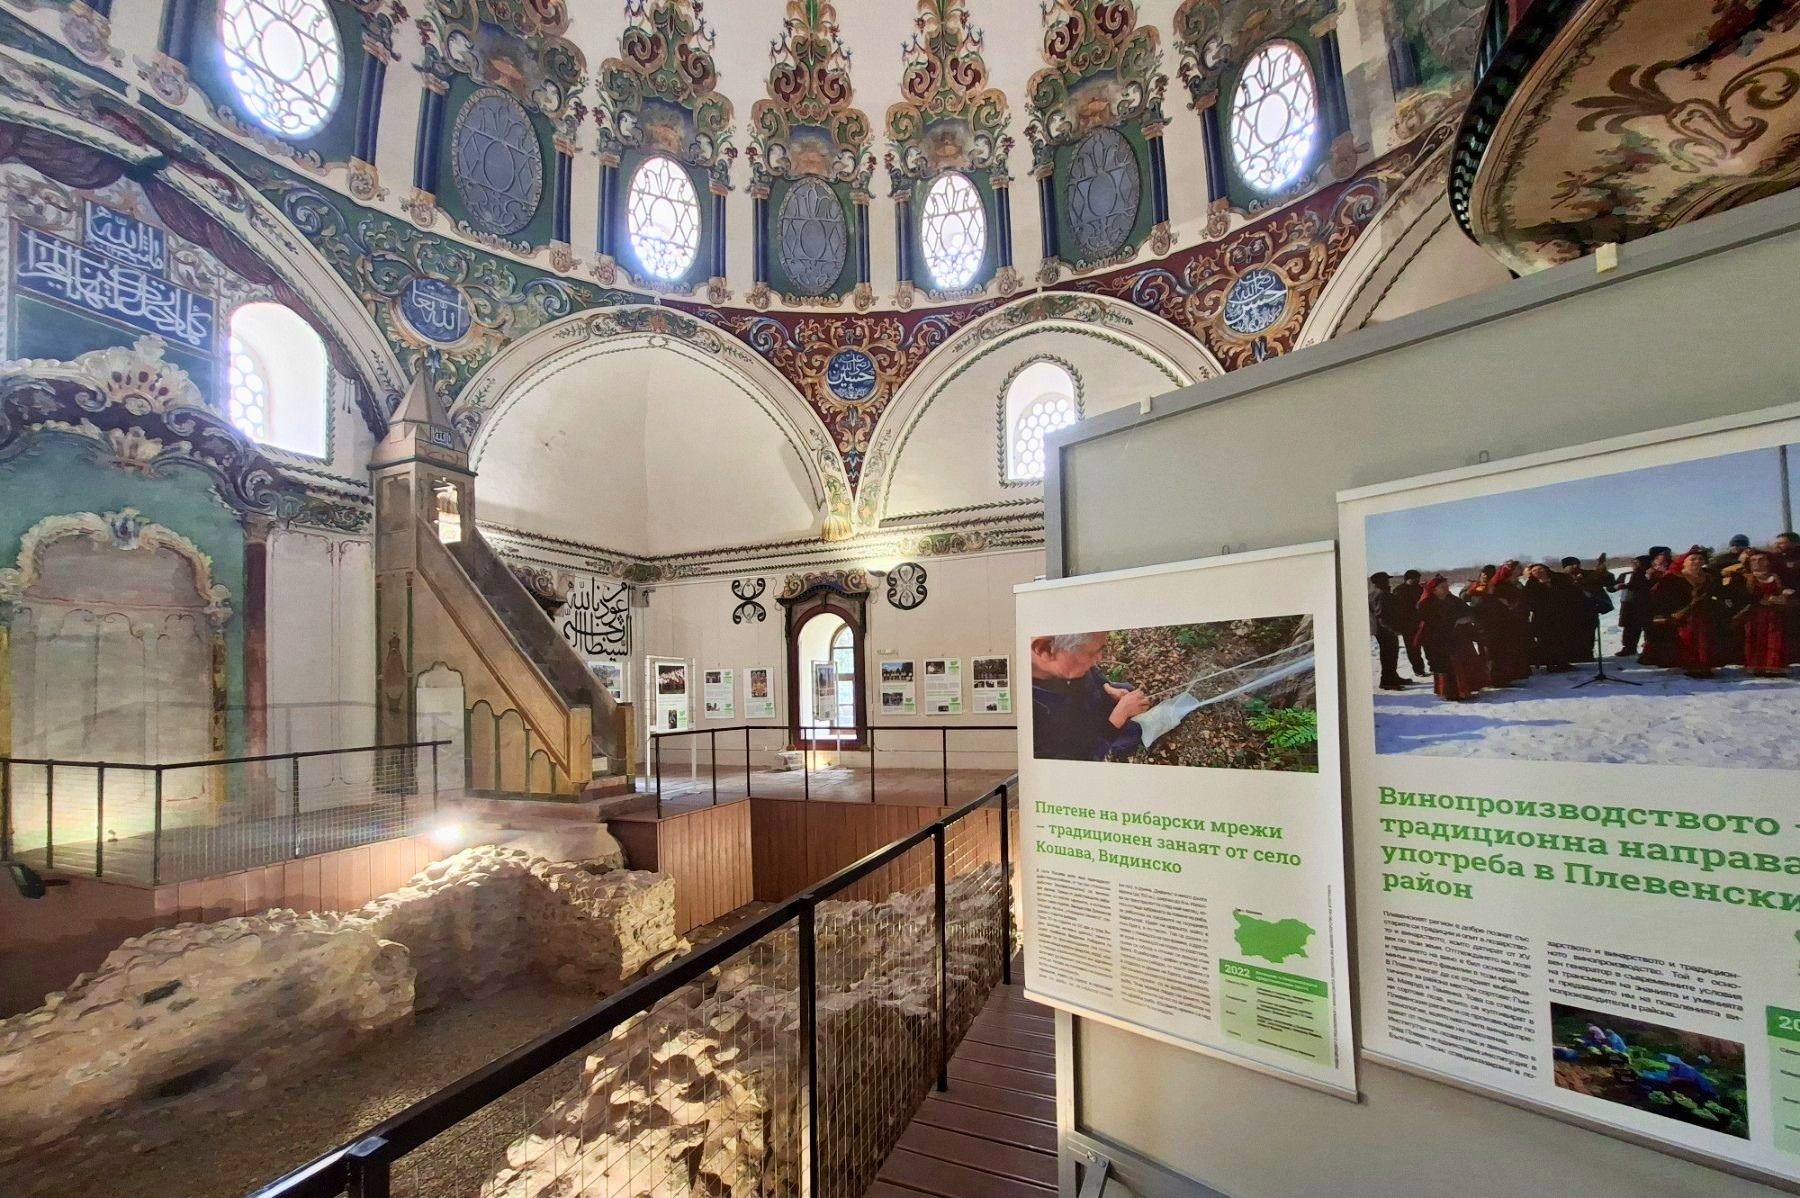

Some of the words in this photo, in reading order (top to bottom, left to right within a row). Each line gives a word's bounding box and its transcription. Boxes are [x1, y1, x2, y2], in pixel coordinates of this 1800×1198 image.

[1035, 800, 1096, 819] Плетене
[1099, 809, 1118, 821] на
[1122, 811, 1205, 831] рибарски
[1210, 820, 1284, 840] мрежи
[1378, 786, 1780, 836] Винопроизводството
[1036, 840, 1096, 863] Кошава,
[1098, 848, 1182, 874] Видинско
[1048, 824, 1153, 848] традиционен
[1156, 837, 1221, 856] занаят
[1225, 846, 1248, 859] от
[1253, 850, 1302, 866] село
[1380, 818, 1608, 855] традиционна
[1618, 840, 1800, 875] направа
[1381, 845, 1525, 877] употреба
[1533, 863, 1555, 880] в
[1564, 862, 1800, 913] Плевенски
[1382, 871, 1474, 899] район
[1224, 964, 1251, 978] 2022
